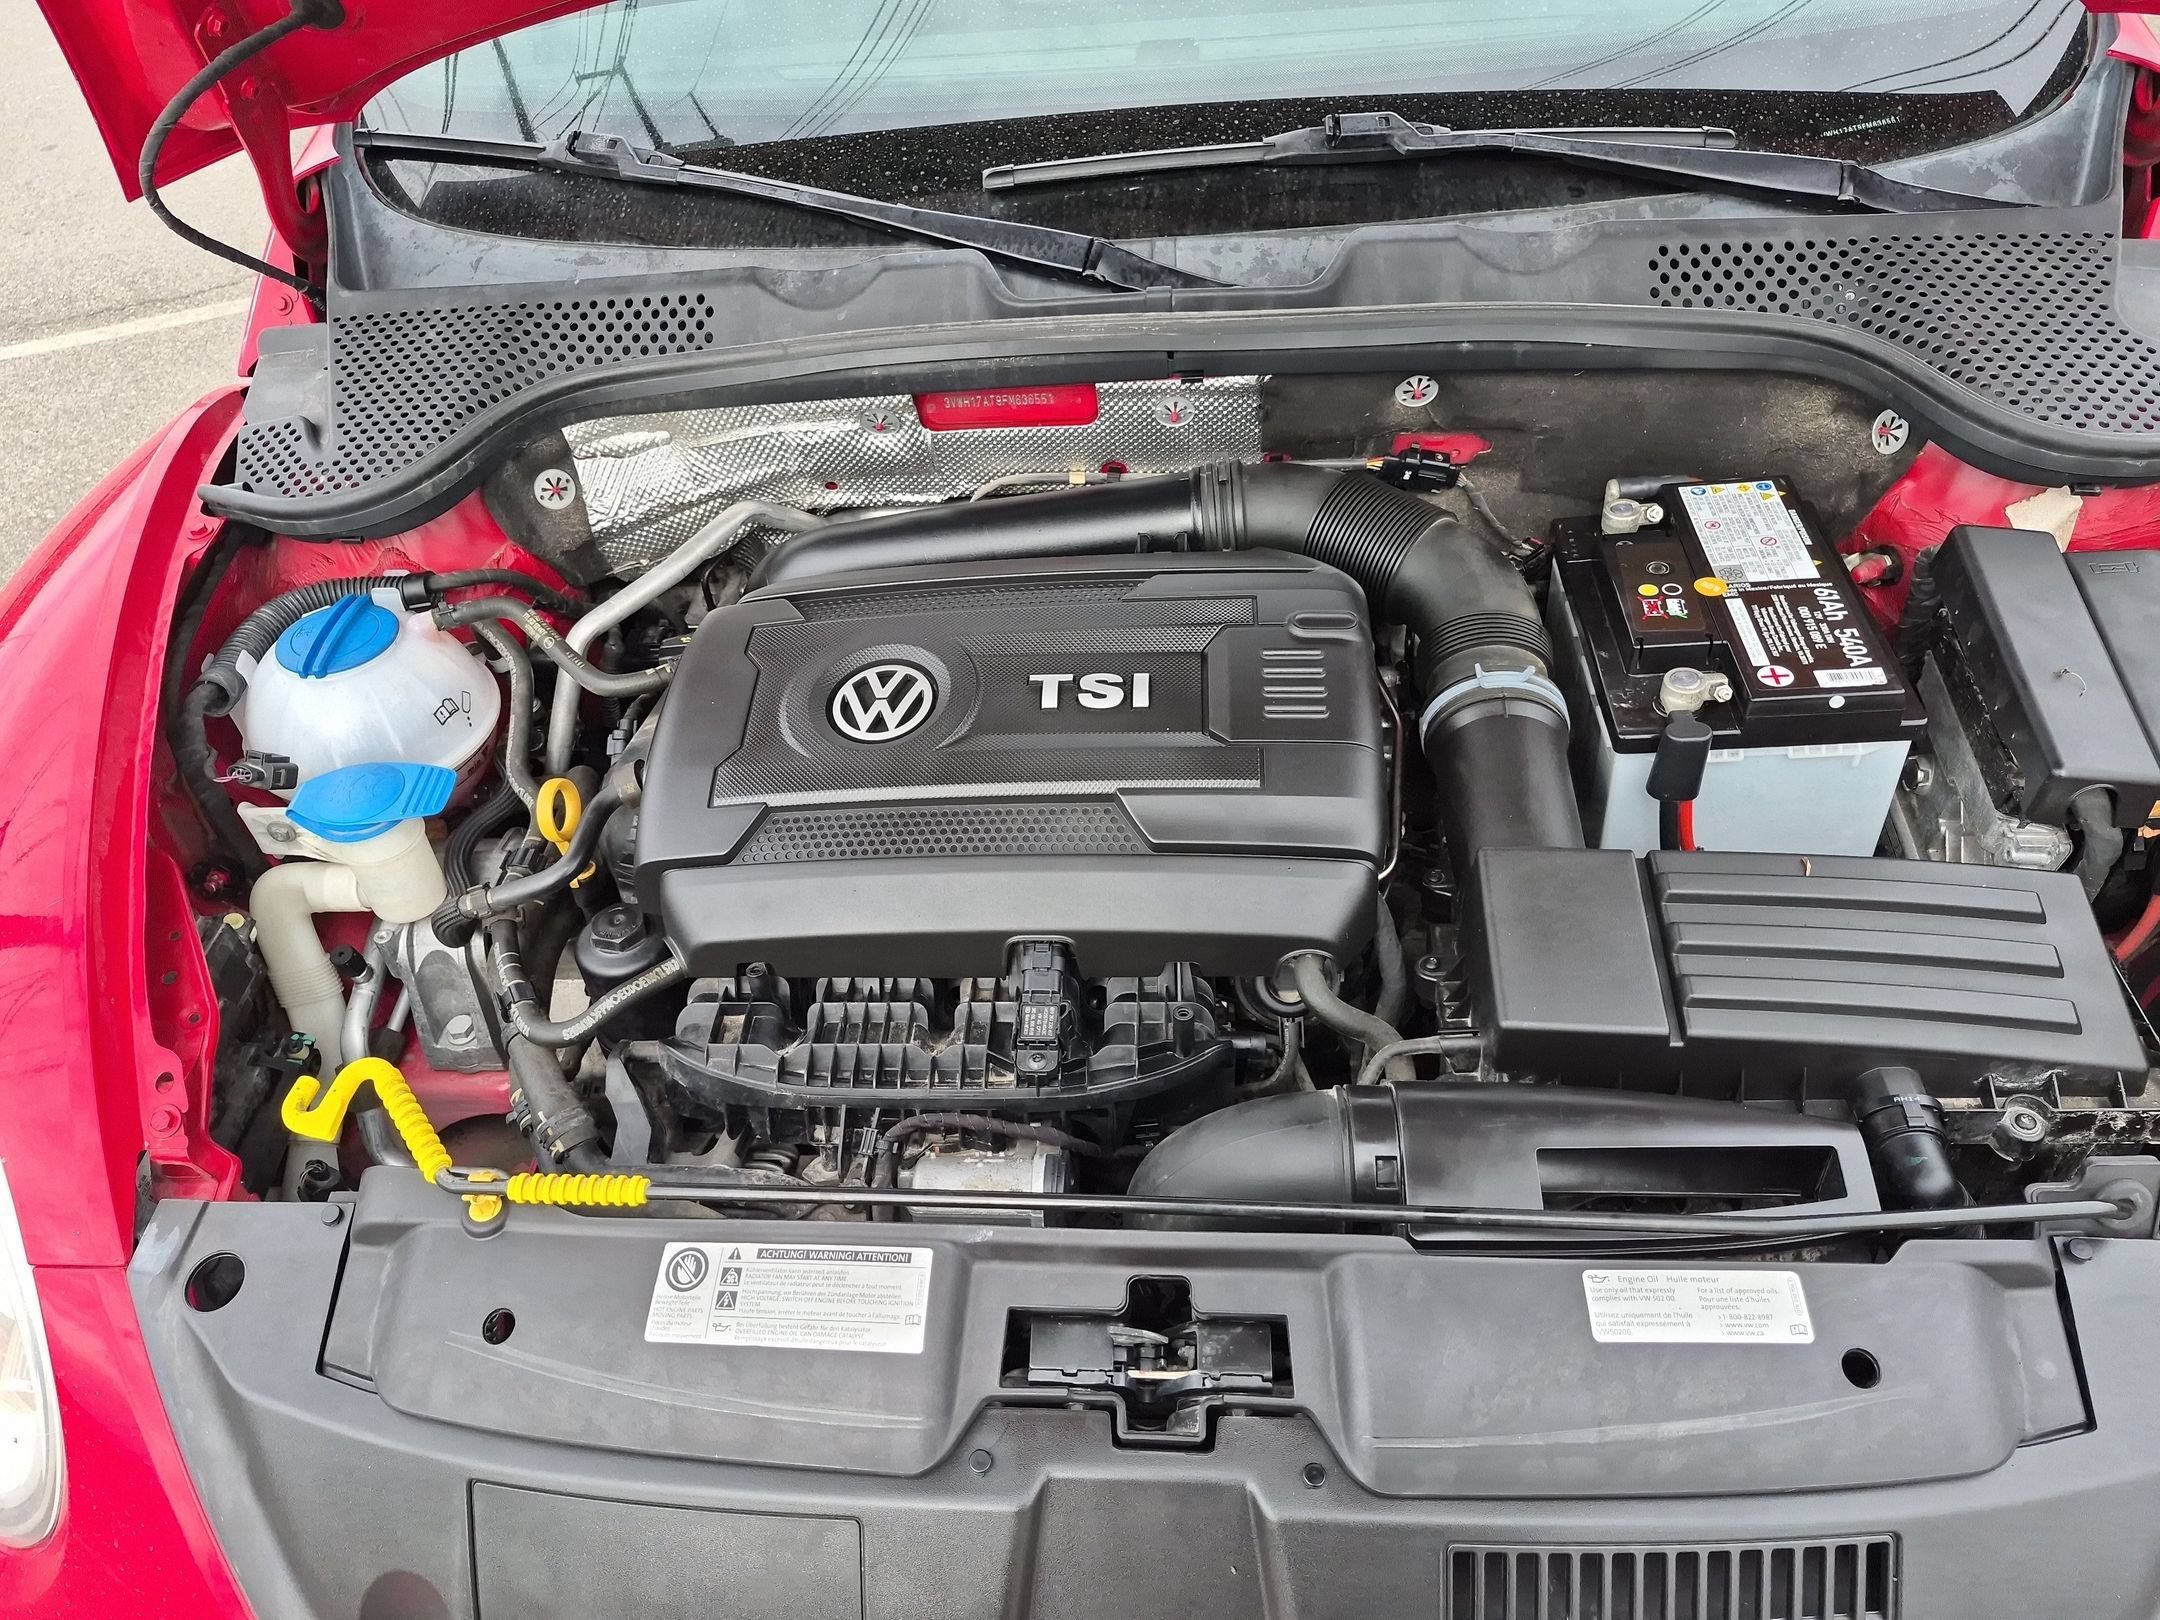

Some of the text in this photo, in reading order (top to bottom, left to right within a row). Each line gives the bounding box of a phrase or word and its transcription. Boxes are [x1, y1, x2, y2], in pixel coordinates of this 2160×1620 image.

[1798, 606, 1812, 618] 000
[1803, 618, 1818, 630] 915
[1814, 588, 1872, 667] 61Ah 540A
[1028, 672, 1151, 710] TSI
[832, 664, 932, 741] VW
[760, 1250, 908, 1262] ACHTUNG! WARNING! ATTENTION!
[1618, 1276, 1646, 1285] Engine
[1621, 1312, 1661, 1320] uniquement
